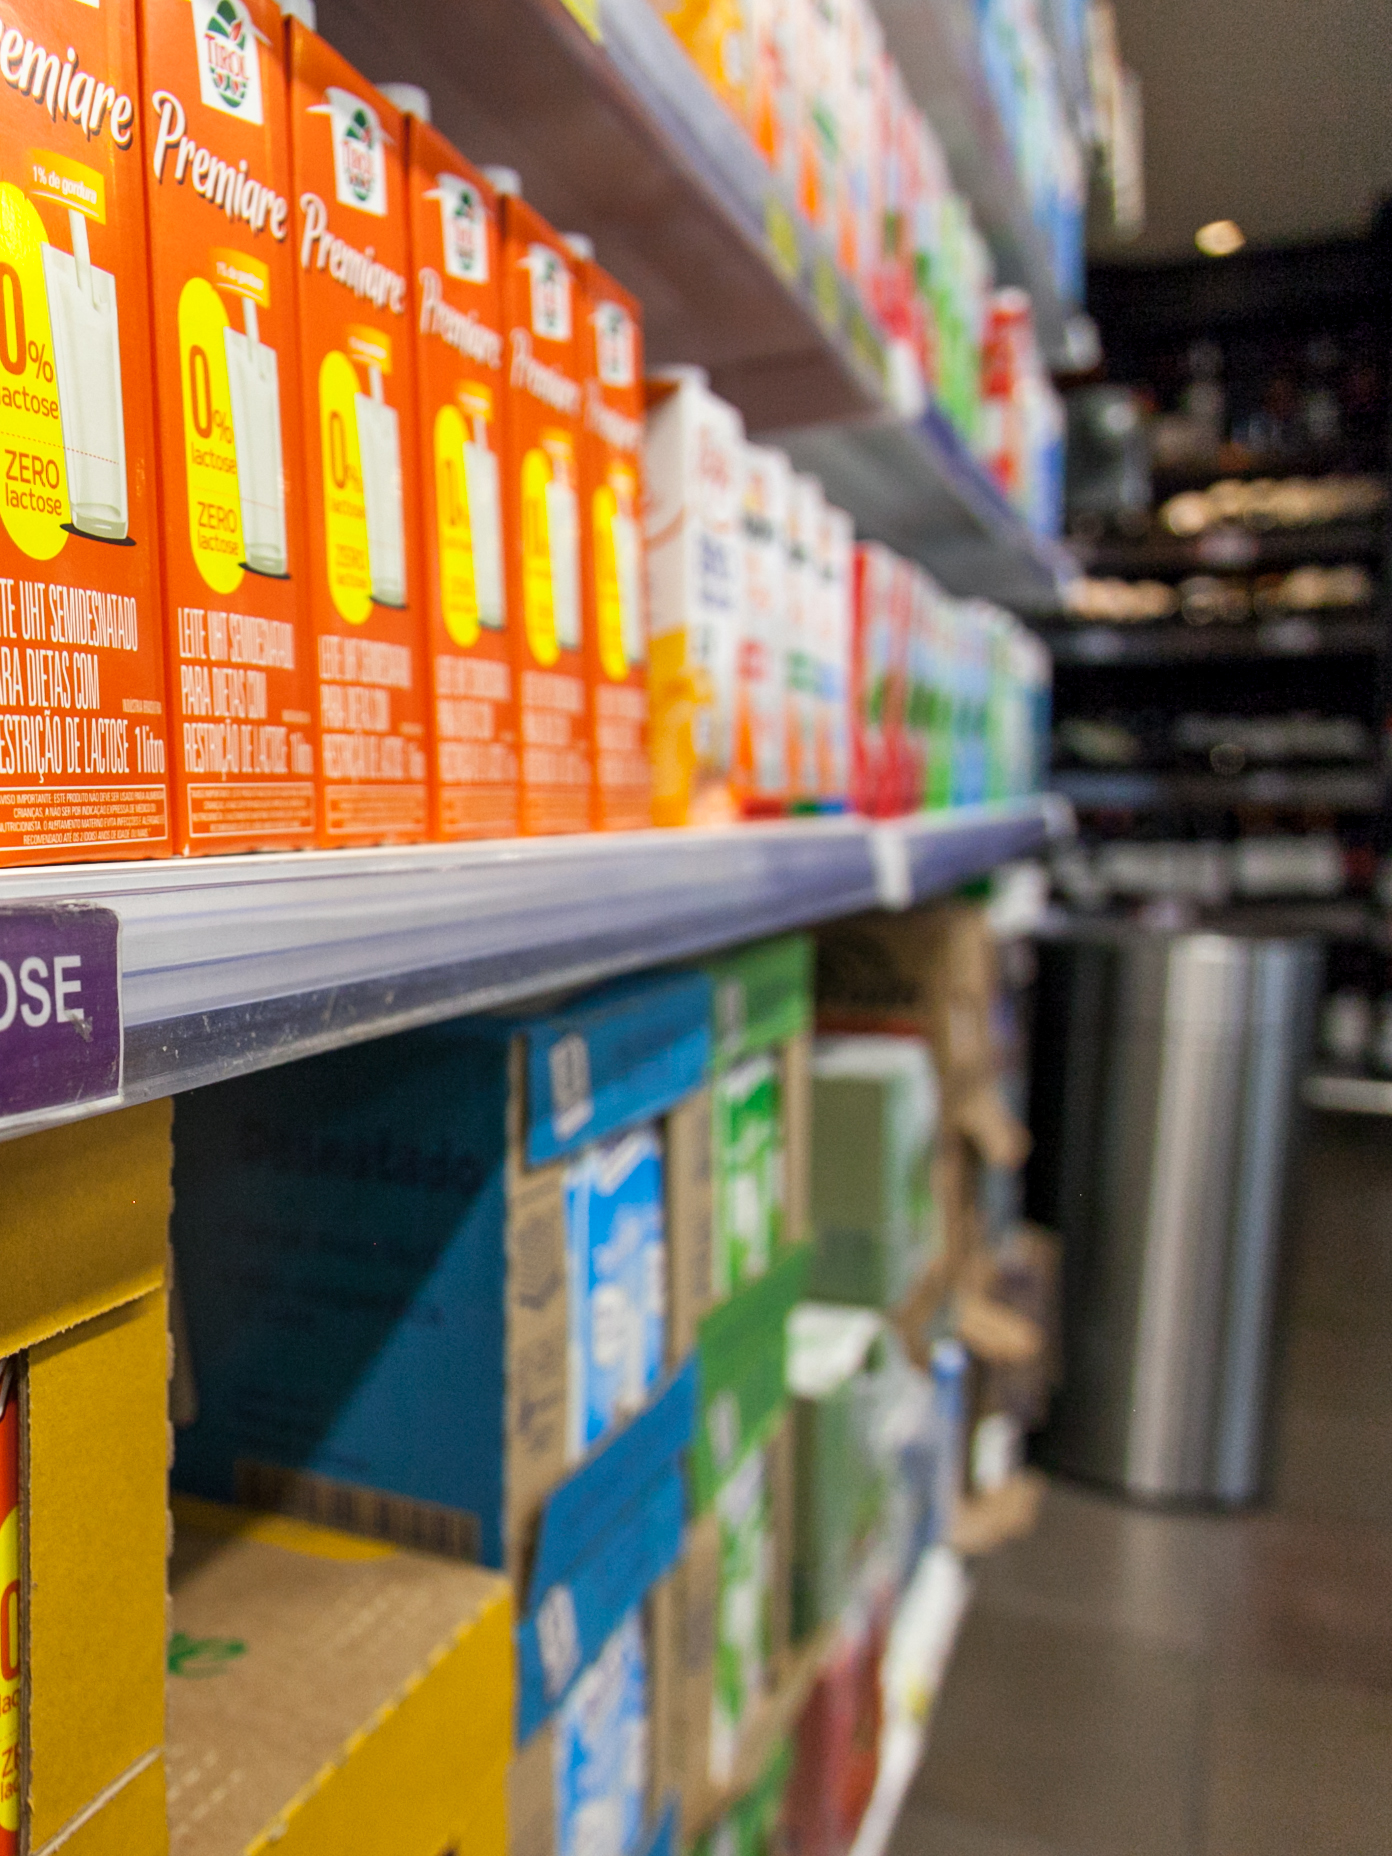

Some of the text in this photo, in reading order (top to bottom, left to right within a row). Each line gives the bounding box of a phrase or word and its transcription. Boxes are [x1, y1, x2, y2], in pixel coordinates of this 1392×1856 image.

[33, 164, 97, 205] 1% de gordura
[152, 90, 288, 240] Premiare
[300, 192, 406, 315] Premiare
[4, 448, 60, 490] ZERO
[191, 442, 237, 475] lactose
[5, 483, 62, 516] lactose
[197, 501, 238, 534] ZERO
[19, 580, 46, 641] UHT
[48, 584, 138, 652] SEMIDESNATADO
[26, 648, 71, 709] DIETAS
[73, 652, 100, 710] COM
[65, 716, 81, 774] DE
[83, 718, 130, 774] LACTOSE
